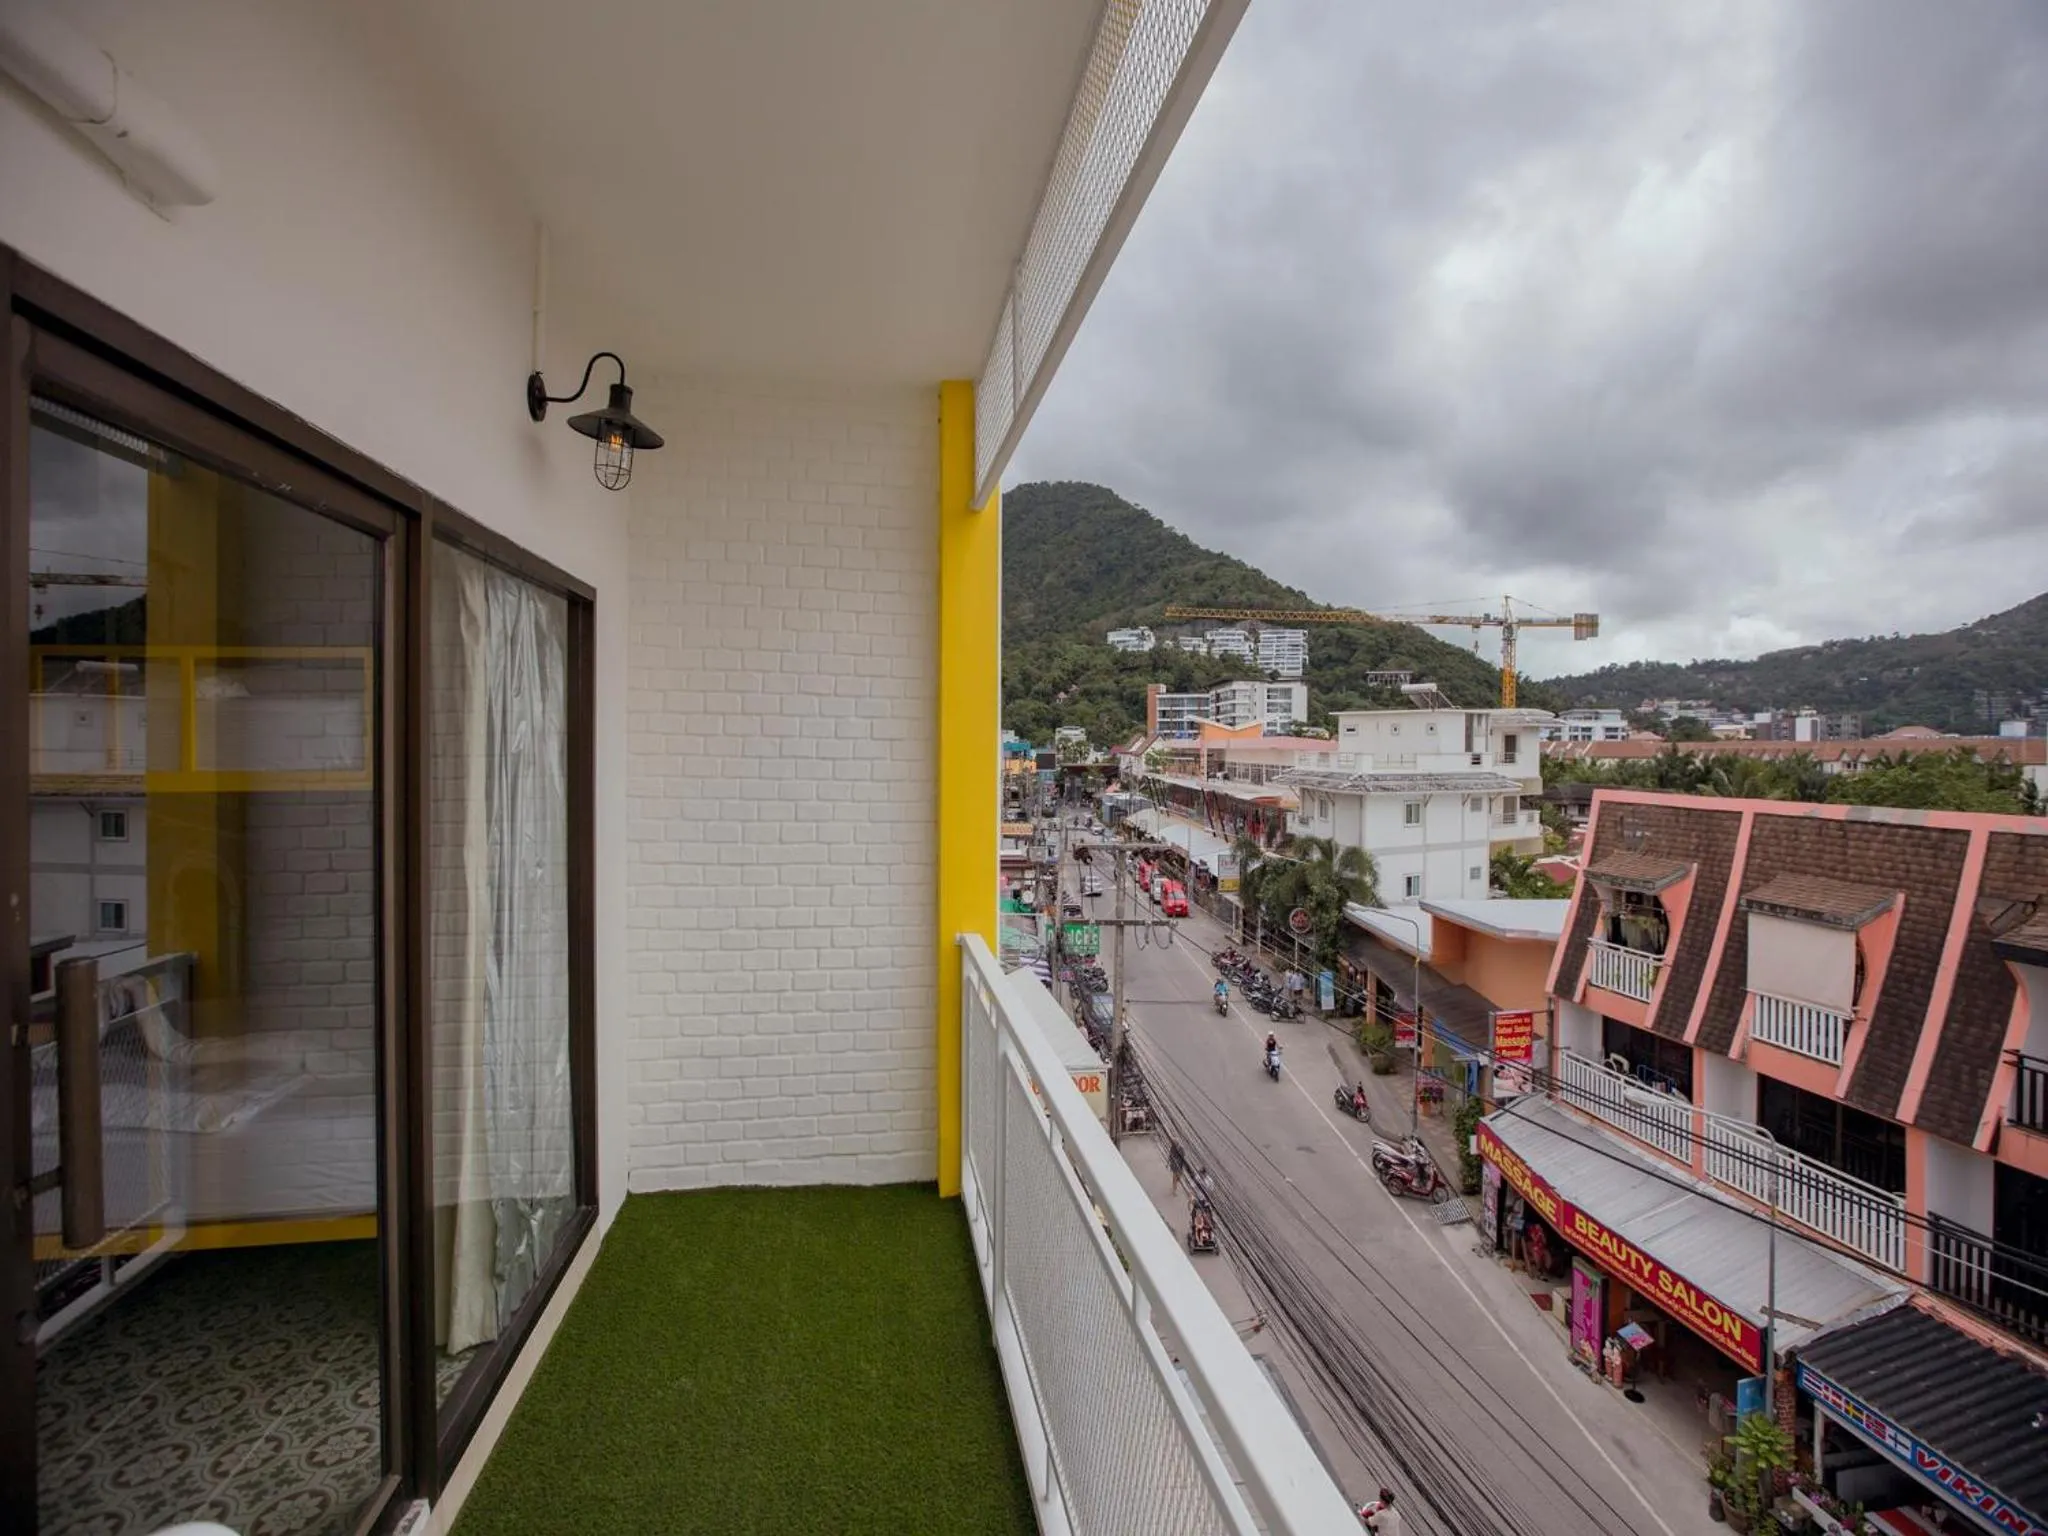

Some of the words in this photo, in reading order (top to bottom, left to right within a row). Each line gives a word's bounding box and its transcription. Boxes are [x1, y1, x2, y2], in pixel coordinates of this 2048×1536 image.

[1496, 1036, 1531, 1048] Massage
[1480, 1134, 1557, 1223] MASSAGE
[1574, 1212, 1653, 1279] BEAUTY
[1658, 1270, 1742, 1341] SALON
[1917, 1447, 2048, 1536] VIKIN
